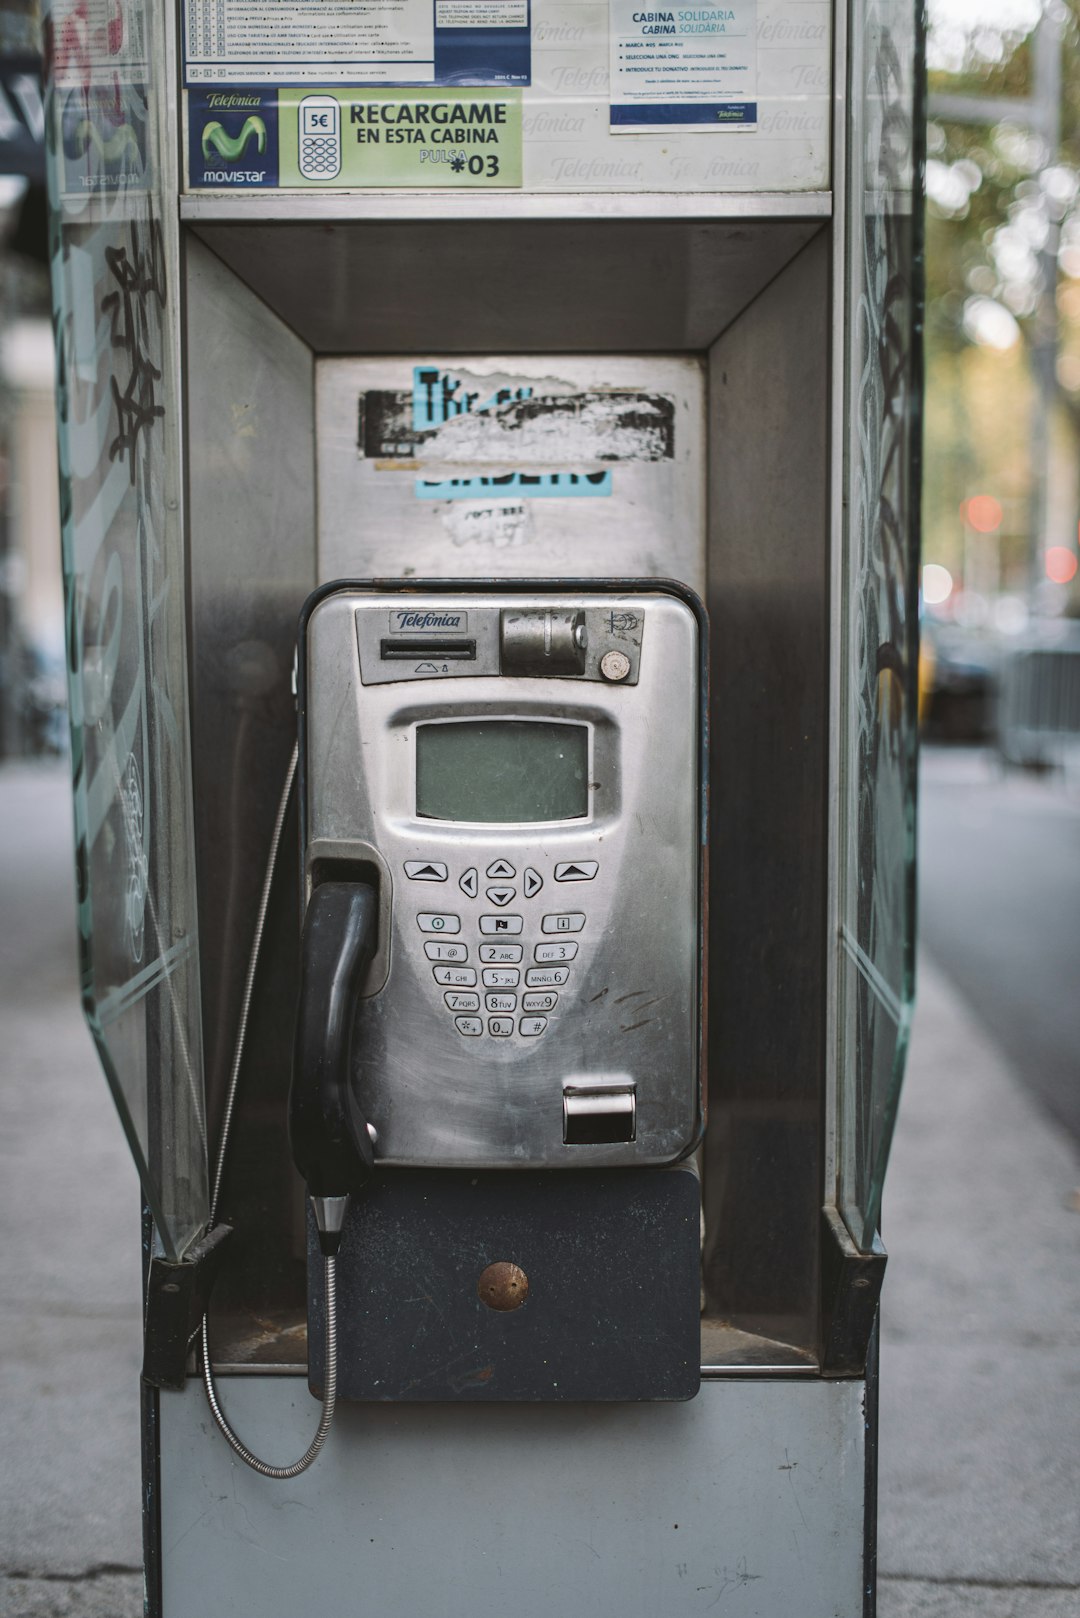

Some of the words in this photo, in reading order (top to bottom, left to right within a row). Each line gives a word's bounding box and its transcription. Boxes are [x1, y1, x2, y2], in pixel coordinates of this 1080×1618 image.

[632, 12, 674, 23] CABINA
[678, 10, 736, 21] SOLIDARIA
[642, 25, 676, 34] CABINA
[350, 103, 506, 124] RECARGAME
[311, 114, 328, 127] 5€
[357, 128, 379, 143] EN
[385, 128, 426, 143] ESTA
[430, 128, 499, 143] CABINA
[420, 150, 468, 163] PULSA
[204, 170, 266, 182] movistar
[437, 947, 441, 957] 1
[448, 949, 457, 958] @
[488, 949, 496, 959] 2
[559, 947, 566, 958] 3
[444, 971, 451, 981] 4
[492, 973, 498, 983] 5
[554, 972, 562, 982] 6
[452, 997, 458, 1006] 7
[490, 998, 498, 1008] 8
[544, 997, 552, 1007] 9
[533, 1022, 542, 1032] #
